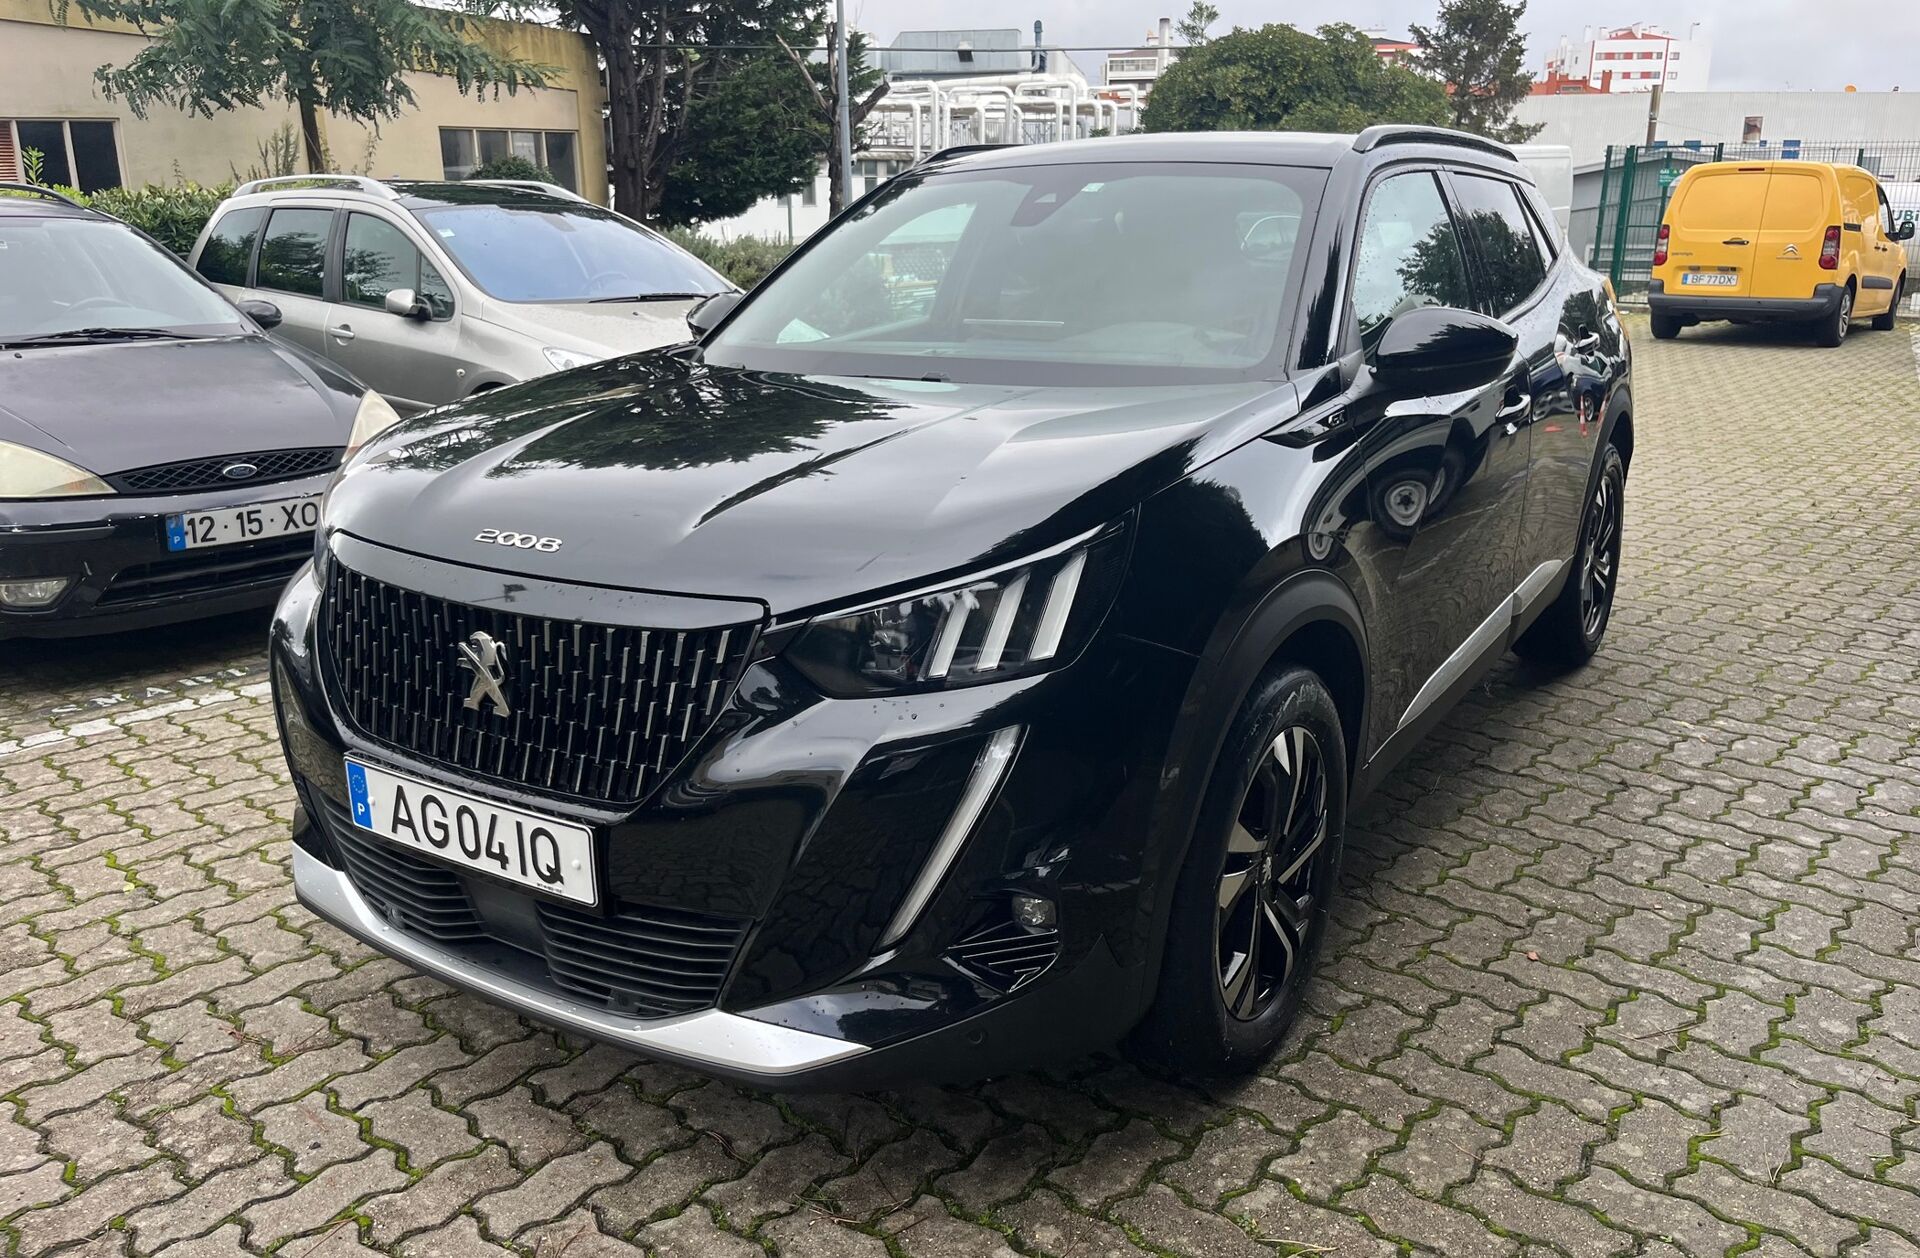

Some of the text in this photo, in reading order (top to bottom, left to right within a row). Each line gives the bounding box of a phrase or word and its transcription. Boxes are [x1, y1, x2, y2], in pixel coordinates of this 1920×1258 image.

[173, 535, 181, 545] P
[474, 528, 563, 553] 2008
[357, 802, 366, 816] P
